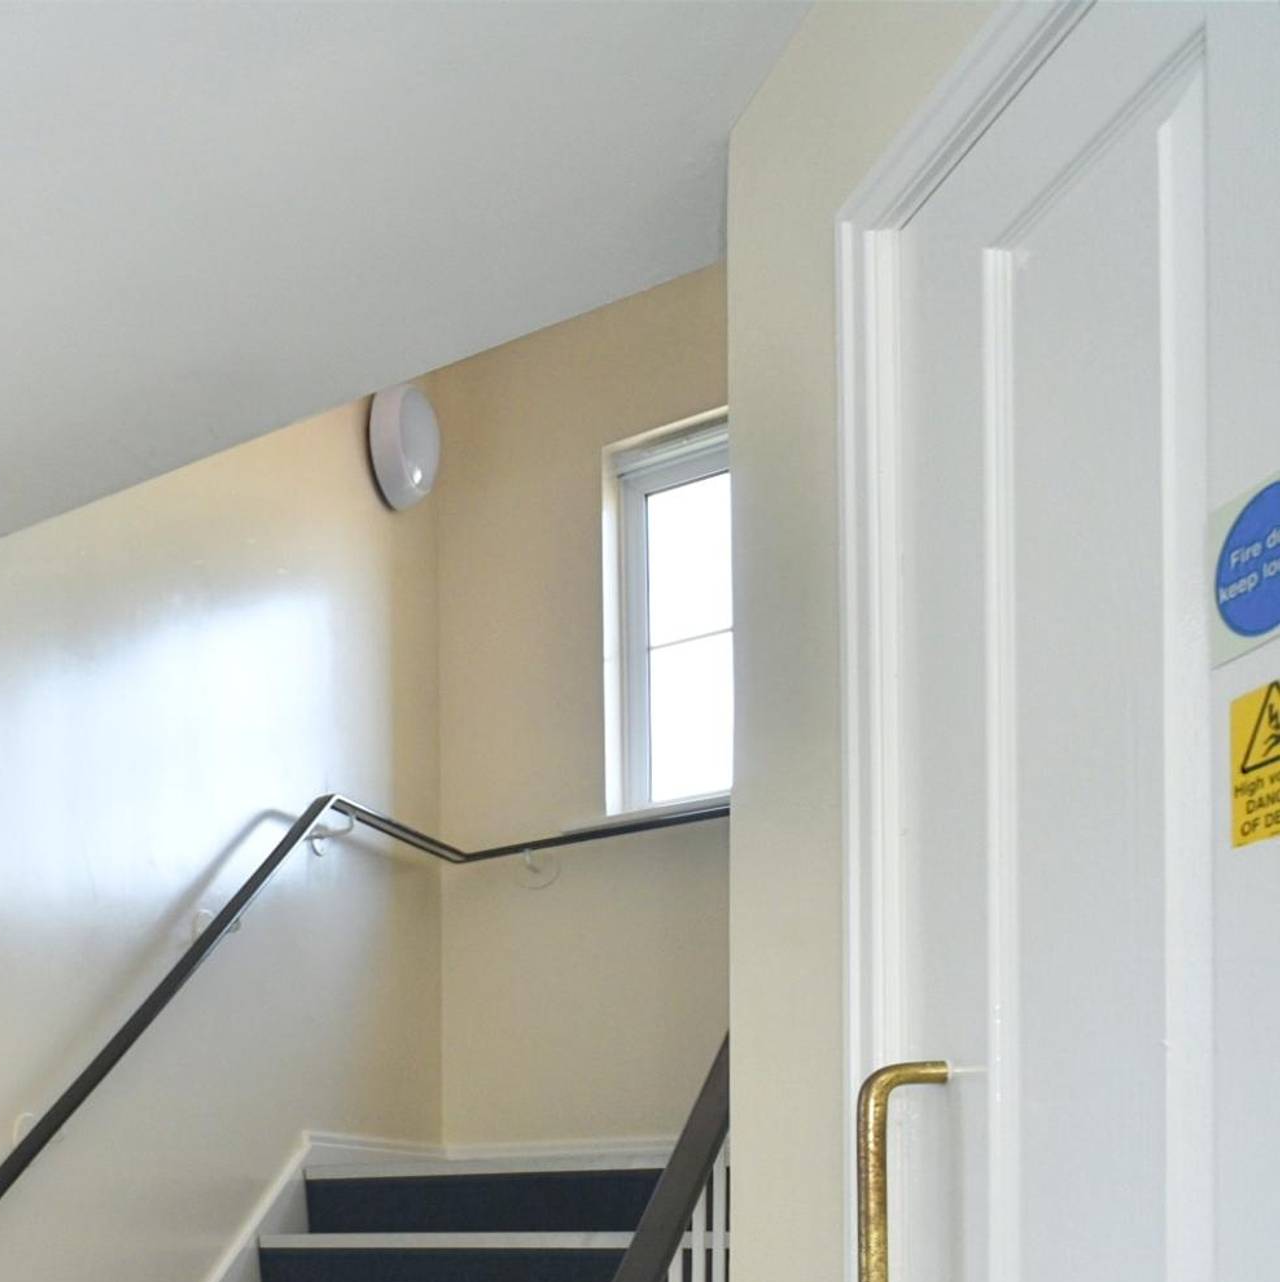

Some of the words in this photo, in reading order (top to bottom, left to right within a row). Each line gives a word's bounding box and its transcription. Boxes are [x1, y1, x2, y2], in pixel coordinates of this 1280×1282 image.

[1231, 541, 1262, 568] Fire
[1219, 571, 1259, 604] keep
[1234, 777, 1265, 799] High
[1241, 816, 1261, 837] OF
